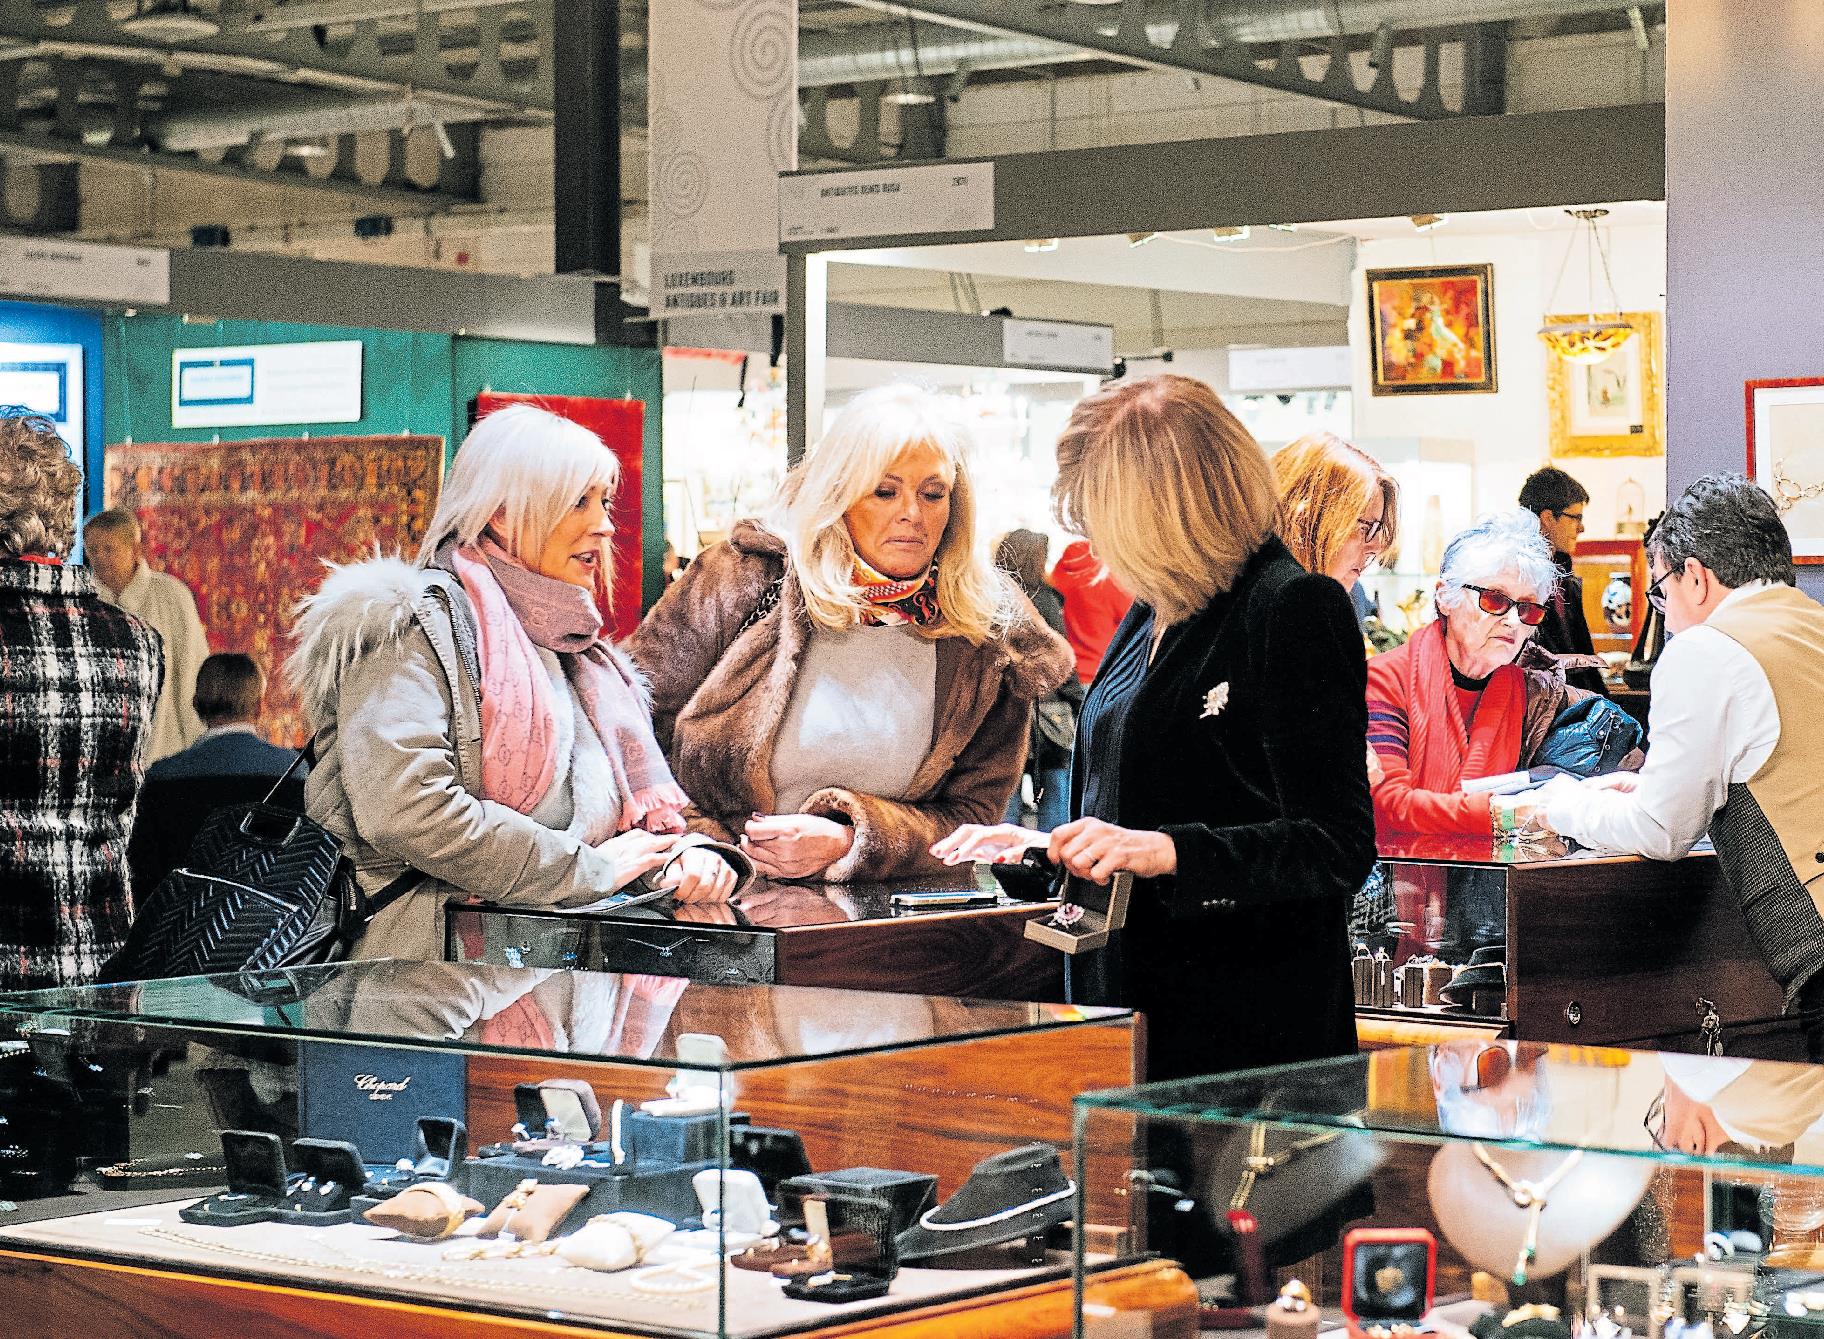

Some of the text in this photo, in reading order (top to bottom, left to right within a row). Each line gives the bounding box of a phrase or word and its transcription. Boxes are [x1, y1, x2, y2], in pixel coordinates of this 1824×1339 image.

[664, 270, 735, 288] LUXEMBOURG
[665, 292, 716, 308] ANTIQUES
[730, 289, 753, 306] ART
[754, 288, 779, 305] FAIR
[354, 1074, 411, 1094] Chopard
